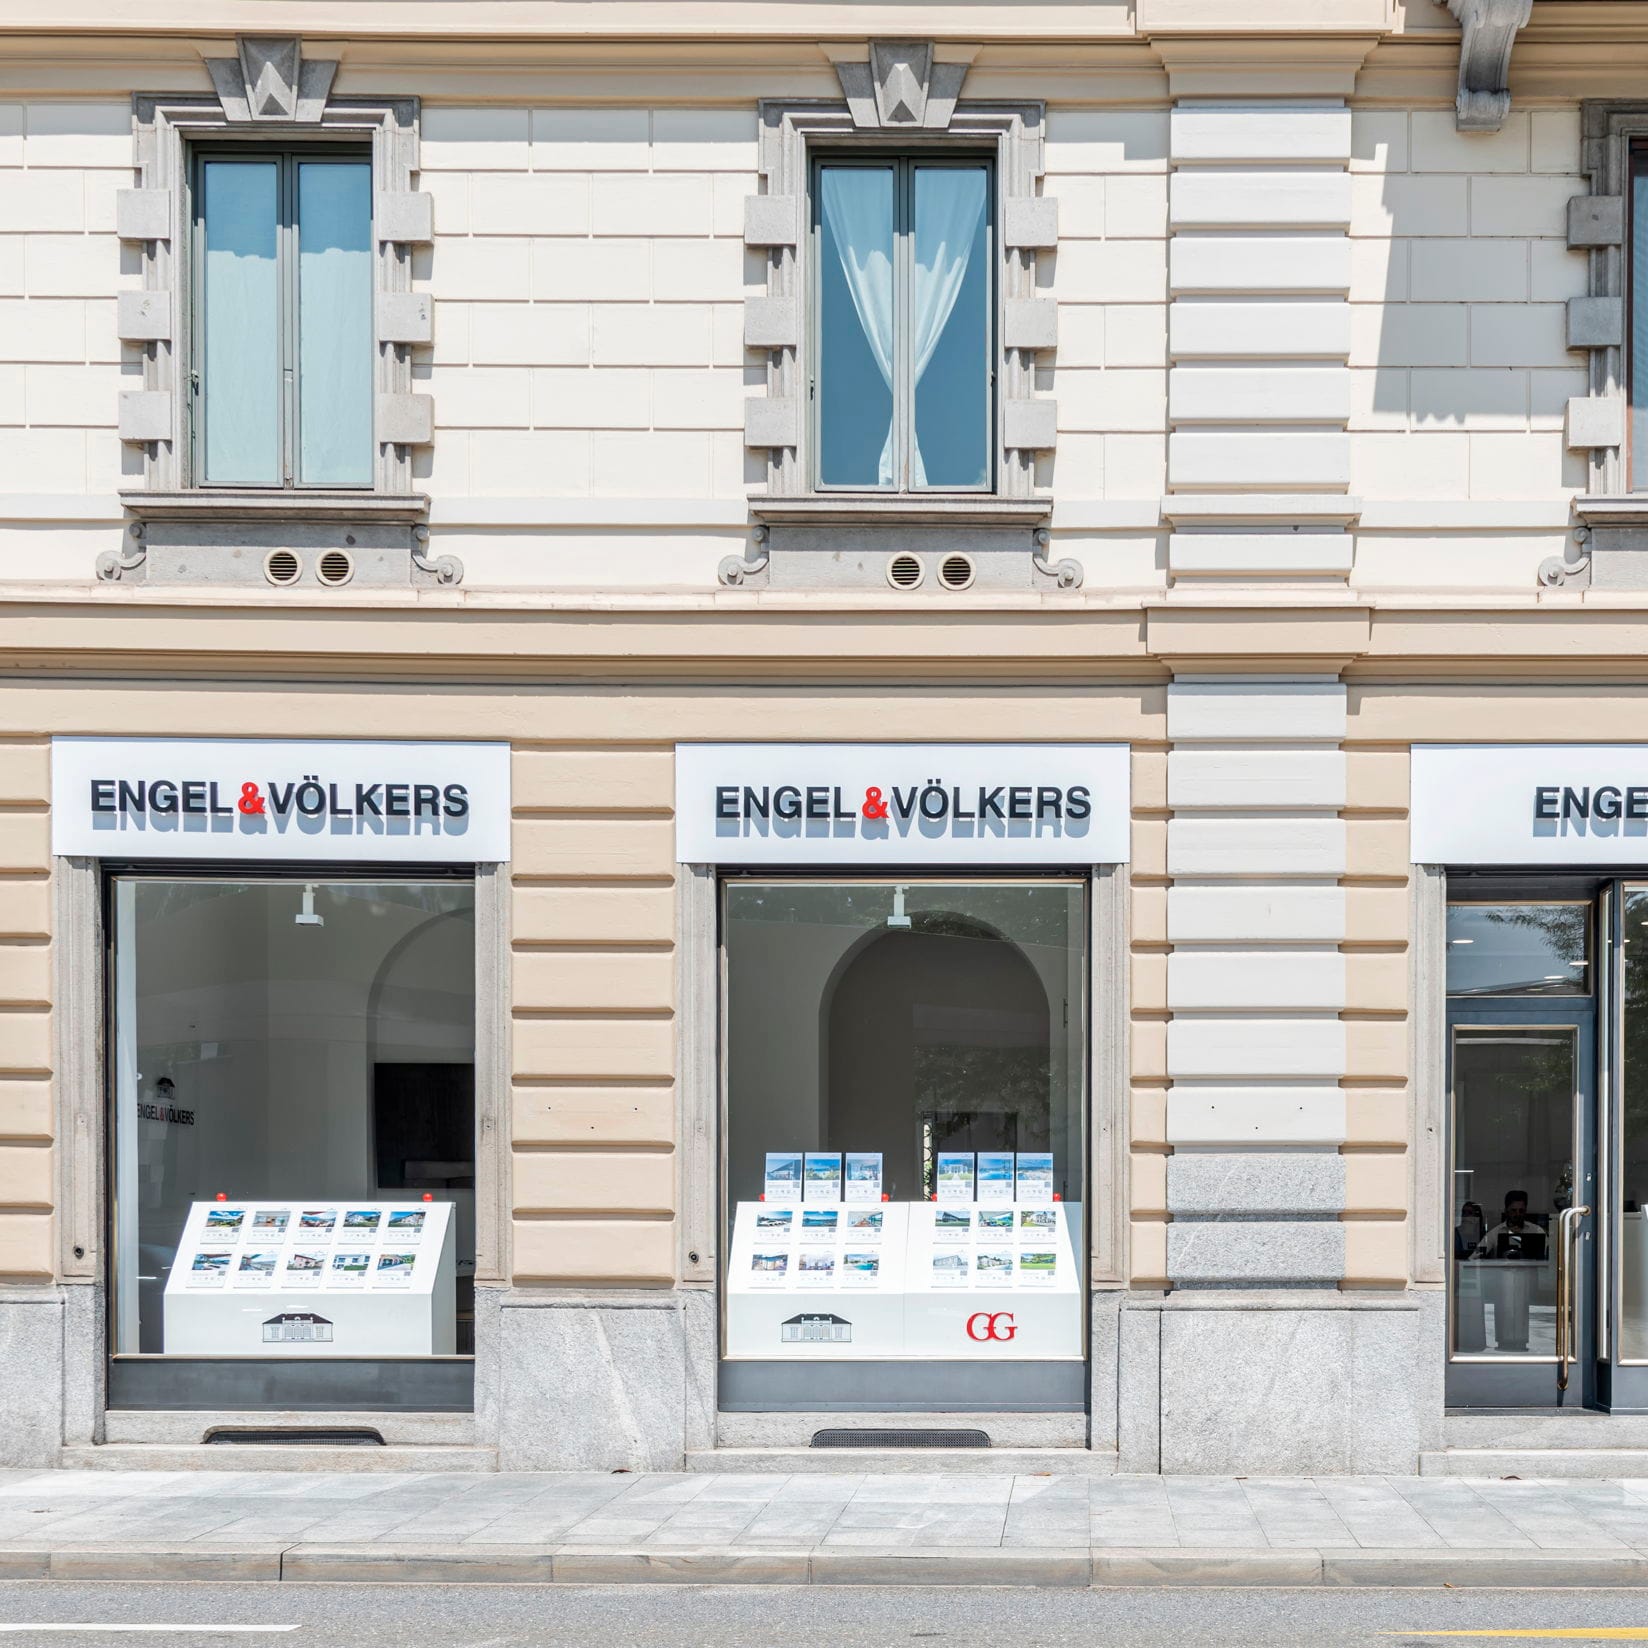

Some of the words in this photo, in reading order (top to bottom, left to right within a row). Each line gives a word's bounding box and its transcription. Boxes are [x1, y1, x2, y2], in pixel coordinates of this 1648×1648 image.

[91, 775, 469, 817] ENGEL&VÖLKERS
[715, 778, 1091, 819] ENGEL&VÖLKERS
[1535, 786, 1648, 819] ENGE
